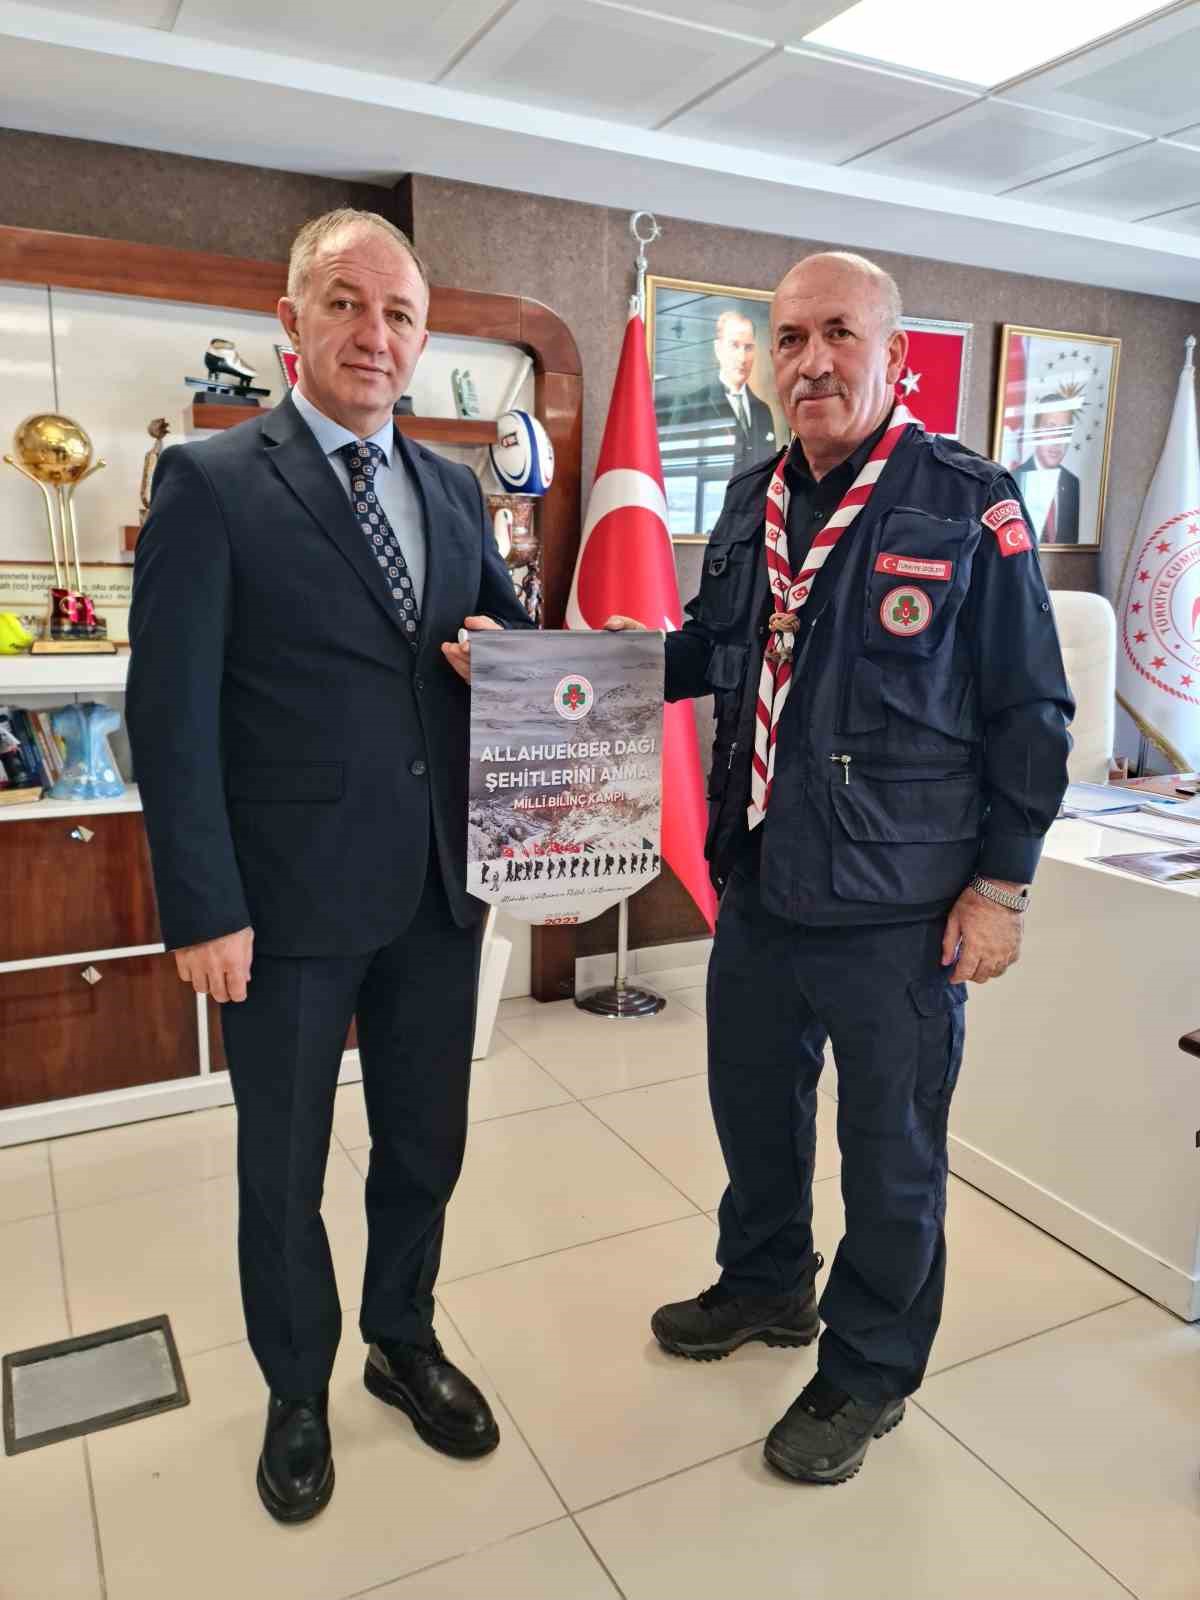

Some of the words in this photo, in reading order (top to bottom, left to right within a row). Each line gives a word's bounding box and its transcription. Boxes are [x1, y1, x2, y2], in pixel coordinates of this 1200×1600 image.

[480, 741, 611, 762] ALLAHUEKBER
[615, 737, 655, 754] DAĞI
[485, 767, 595, 792] ŞEHİTLERİNİ
[600, 766, 649, 782] ANMA
